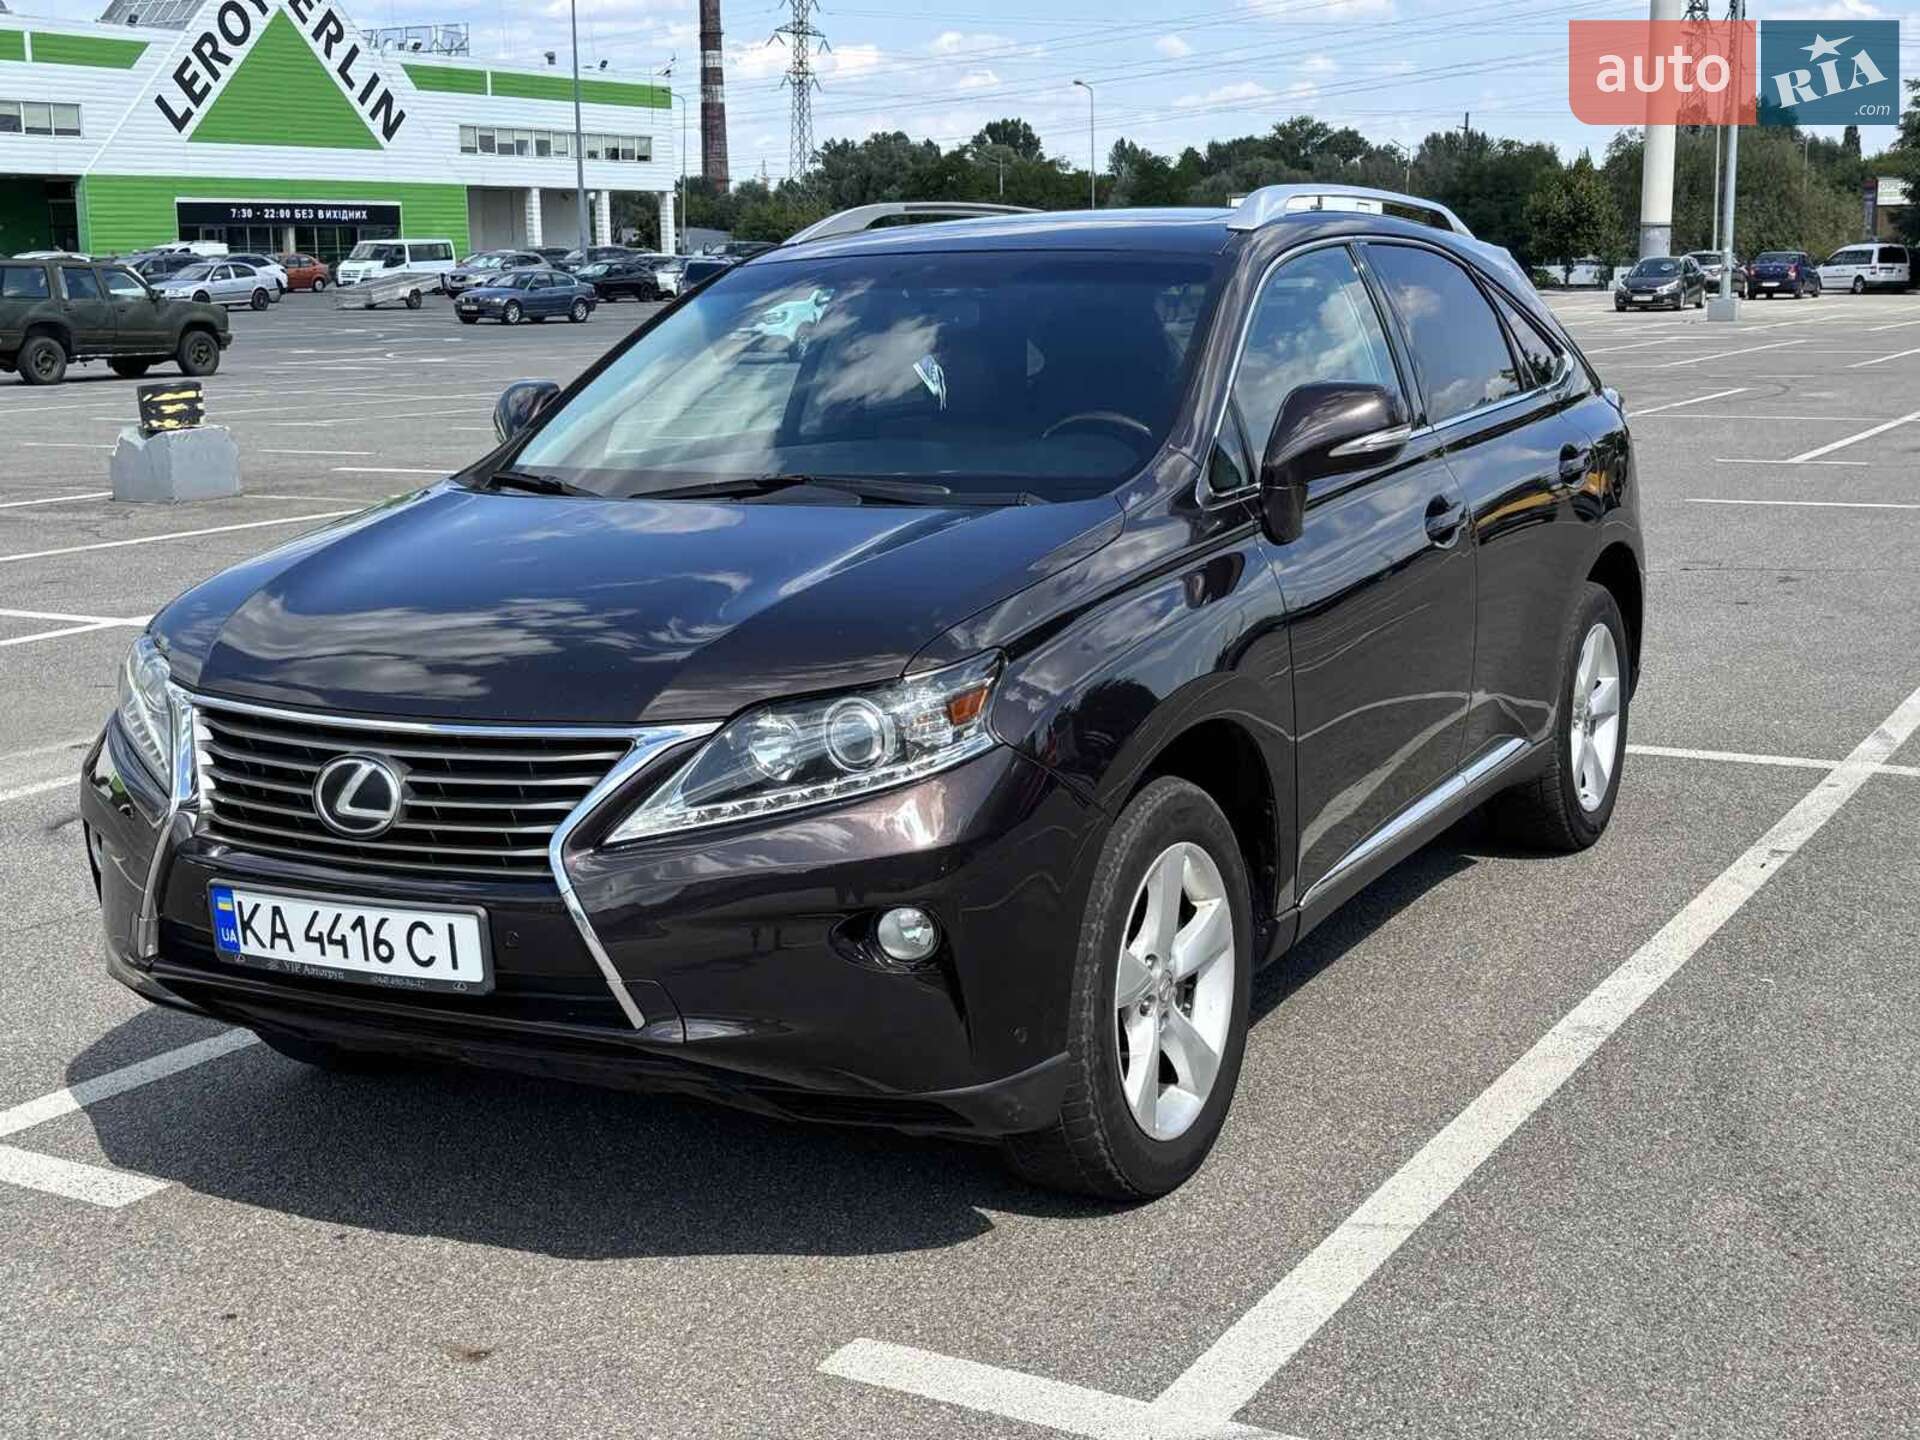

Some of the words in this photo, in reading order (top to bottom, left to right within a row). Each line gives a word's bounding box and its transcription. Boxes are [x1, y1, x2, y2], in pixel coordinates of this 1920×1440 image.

[230, 208, 253, 218] 7:30
[263, 209, 291, 219] 22:00
[294, 209, 314, 219] БЕЗ
[318, 209, 368, 221] ВИХІДНИХ
[220, 928, 238, 944] UA
[237, 900, 294, 953] KA
[304, 910, 395, 964] 4416
